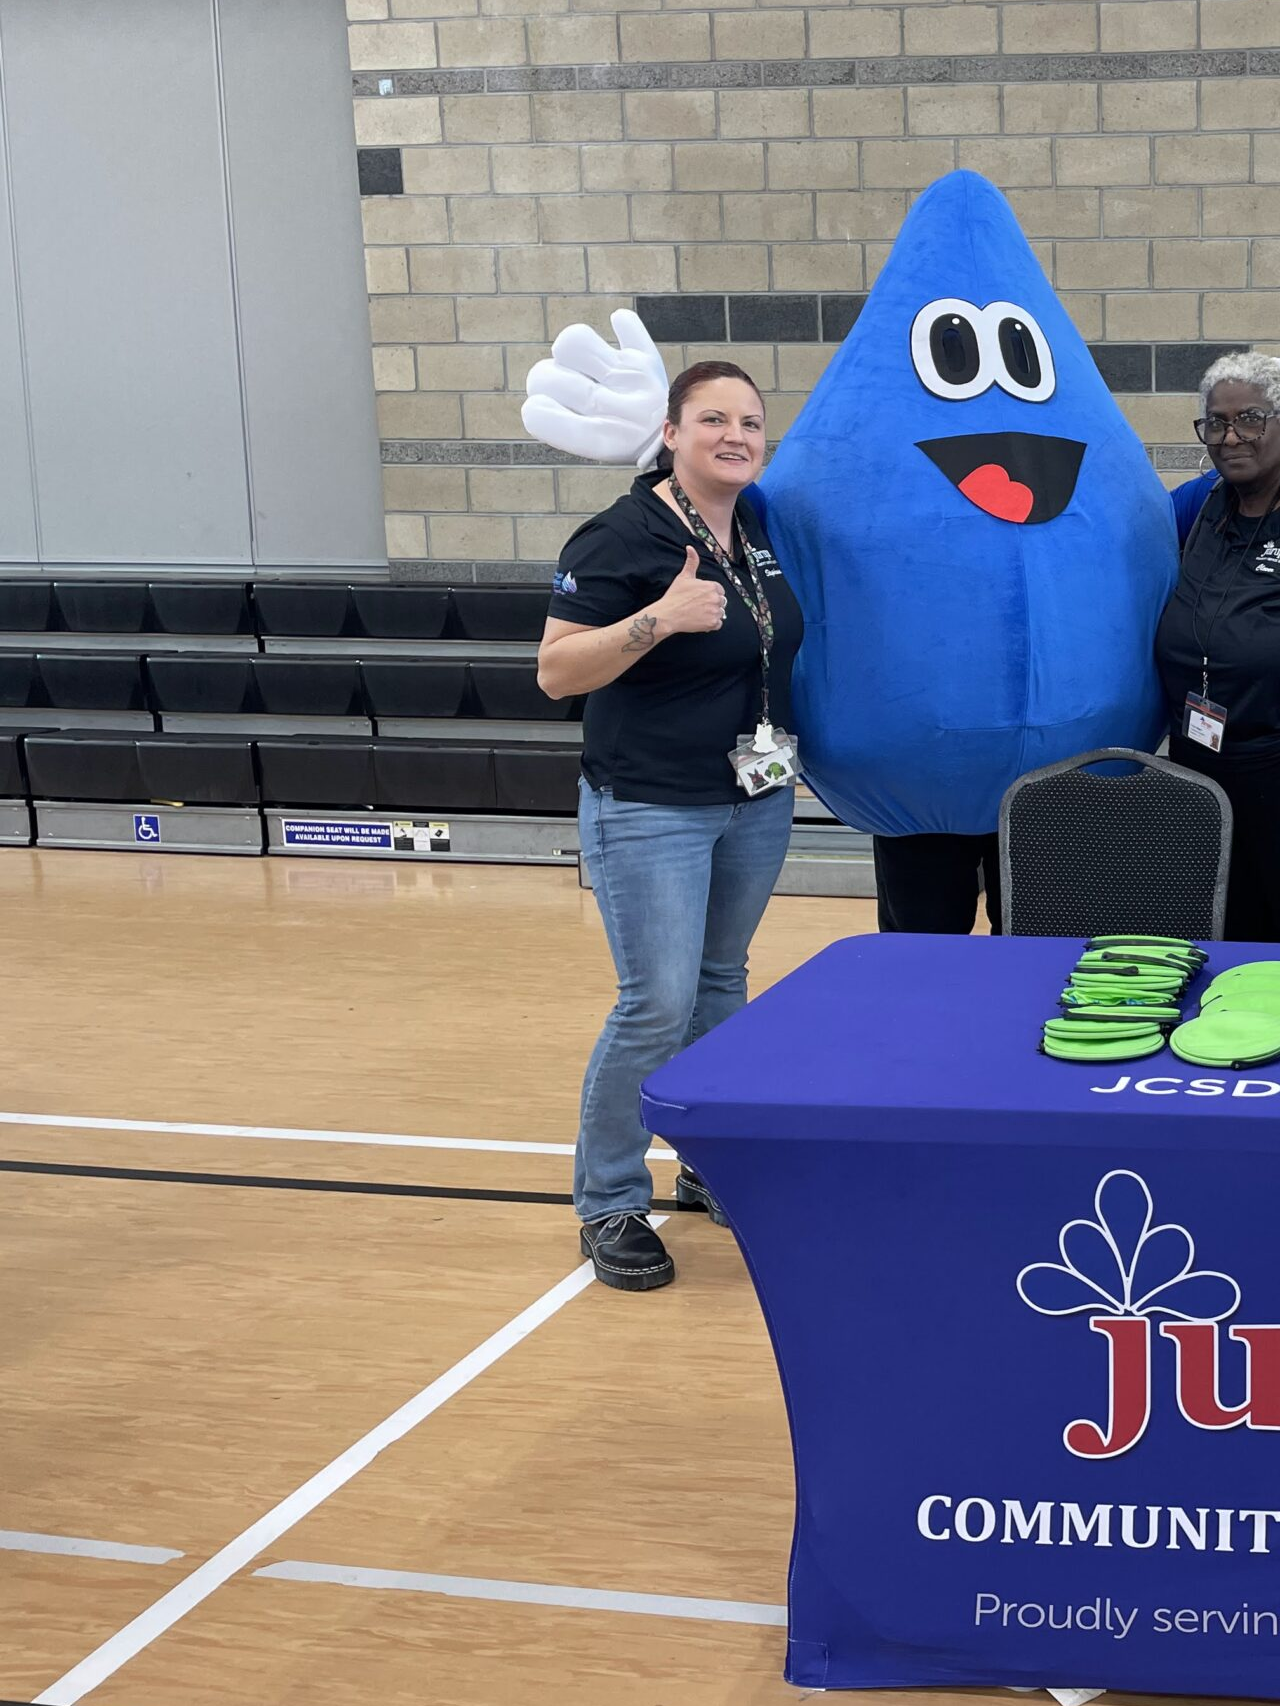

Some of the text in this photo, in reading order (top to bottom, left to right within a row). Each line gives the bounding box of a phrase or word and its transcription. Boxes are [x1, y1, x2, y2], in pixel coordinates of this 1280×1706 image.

[285, 825, 325, 833] COMPANION
[326, 826, 343, 834] SEAT
[371, 828, 390, 836] MADE
[294, 833, 382, 844] AVAILABLE UPON REQUEST
[974, 1593, 1139, 1640] Proudly
